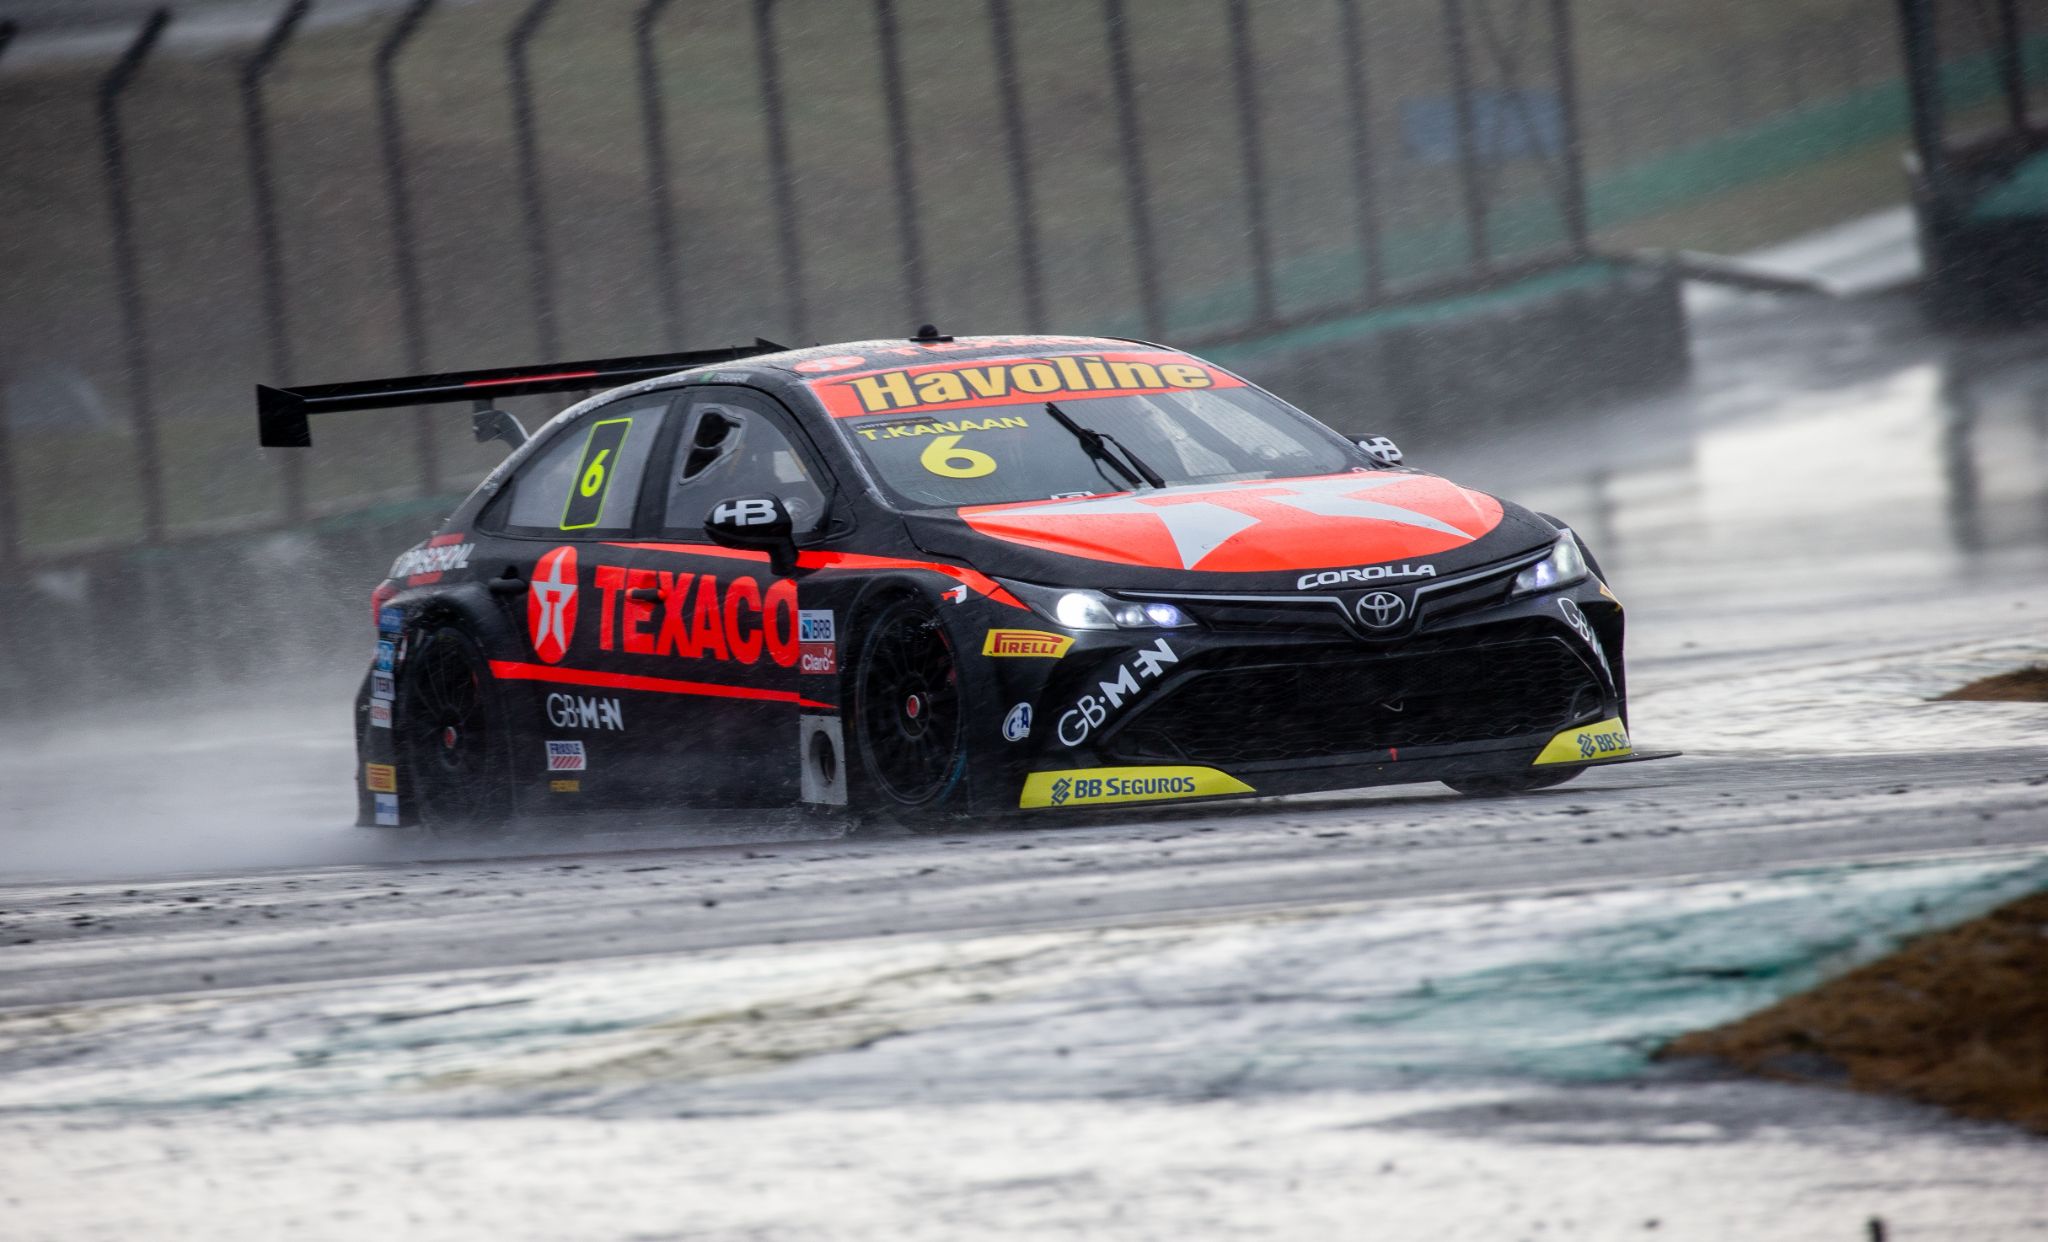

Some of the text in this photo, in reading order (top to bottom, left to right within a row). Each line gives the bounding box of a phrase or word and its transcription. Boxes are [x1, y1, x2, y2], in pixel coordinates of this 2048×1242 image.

[849, 354, 1213, 413] Havoline
[857, 416, 1029, 441] T.KANAAN
[920, 434, 998, 479] 6
[580, 448, 610, 498] 6
[713, 499, 777, 526] HB
[1297, 564, 1436, 590] COROLLA
[594, 564, 799, 668] TEXACO
[813, 619, 832, 639] BRB
[993, 632, 1064, 654] PIRELLI
[802, 653, 831, 671] Claro
[1594, 734, 1614, 753] BB
[1074, 777, 1195, 798] BB SEGUROS
